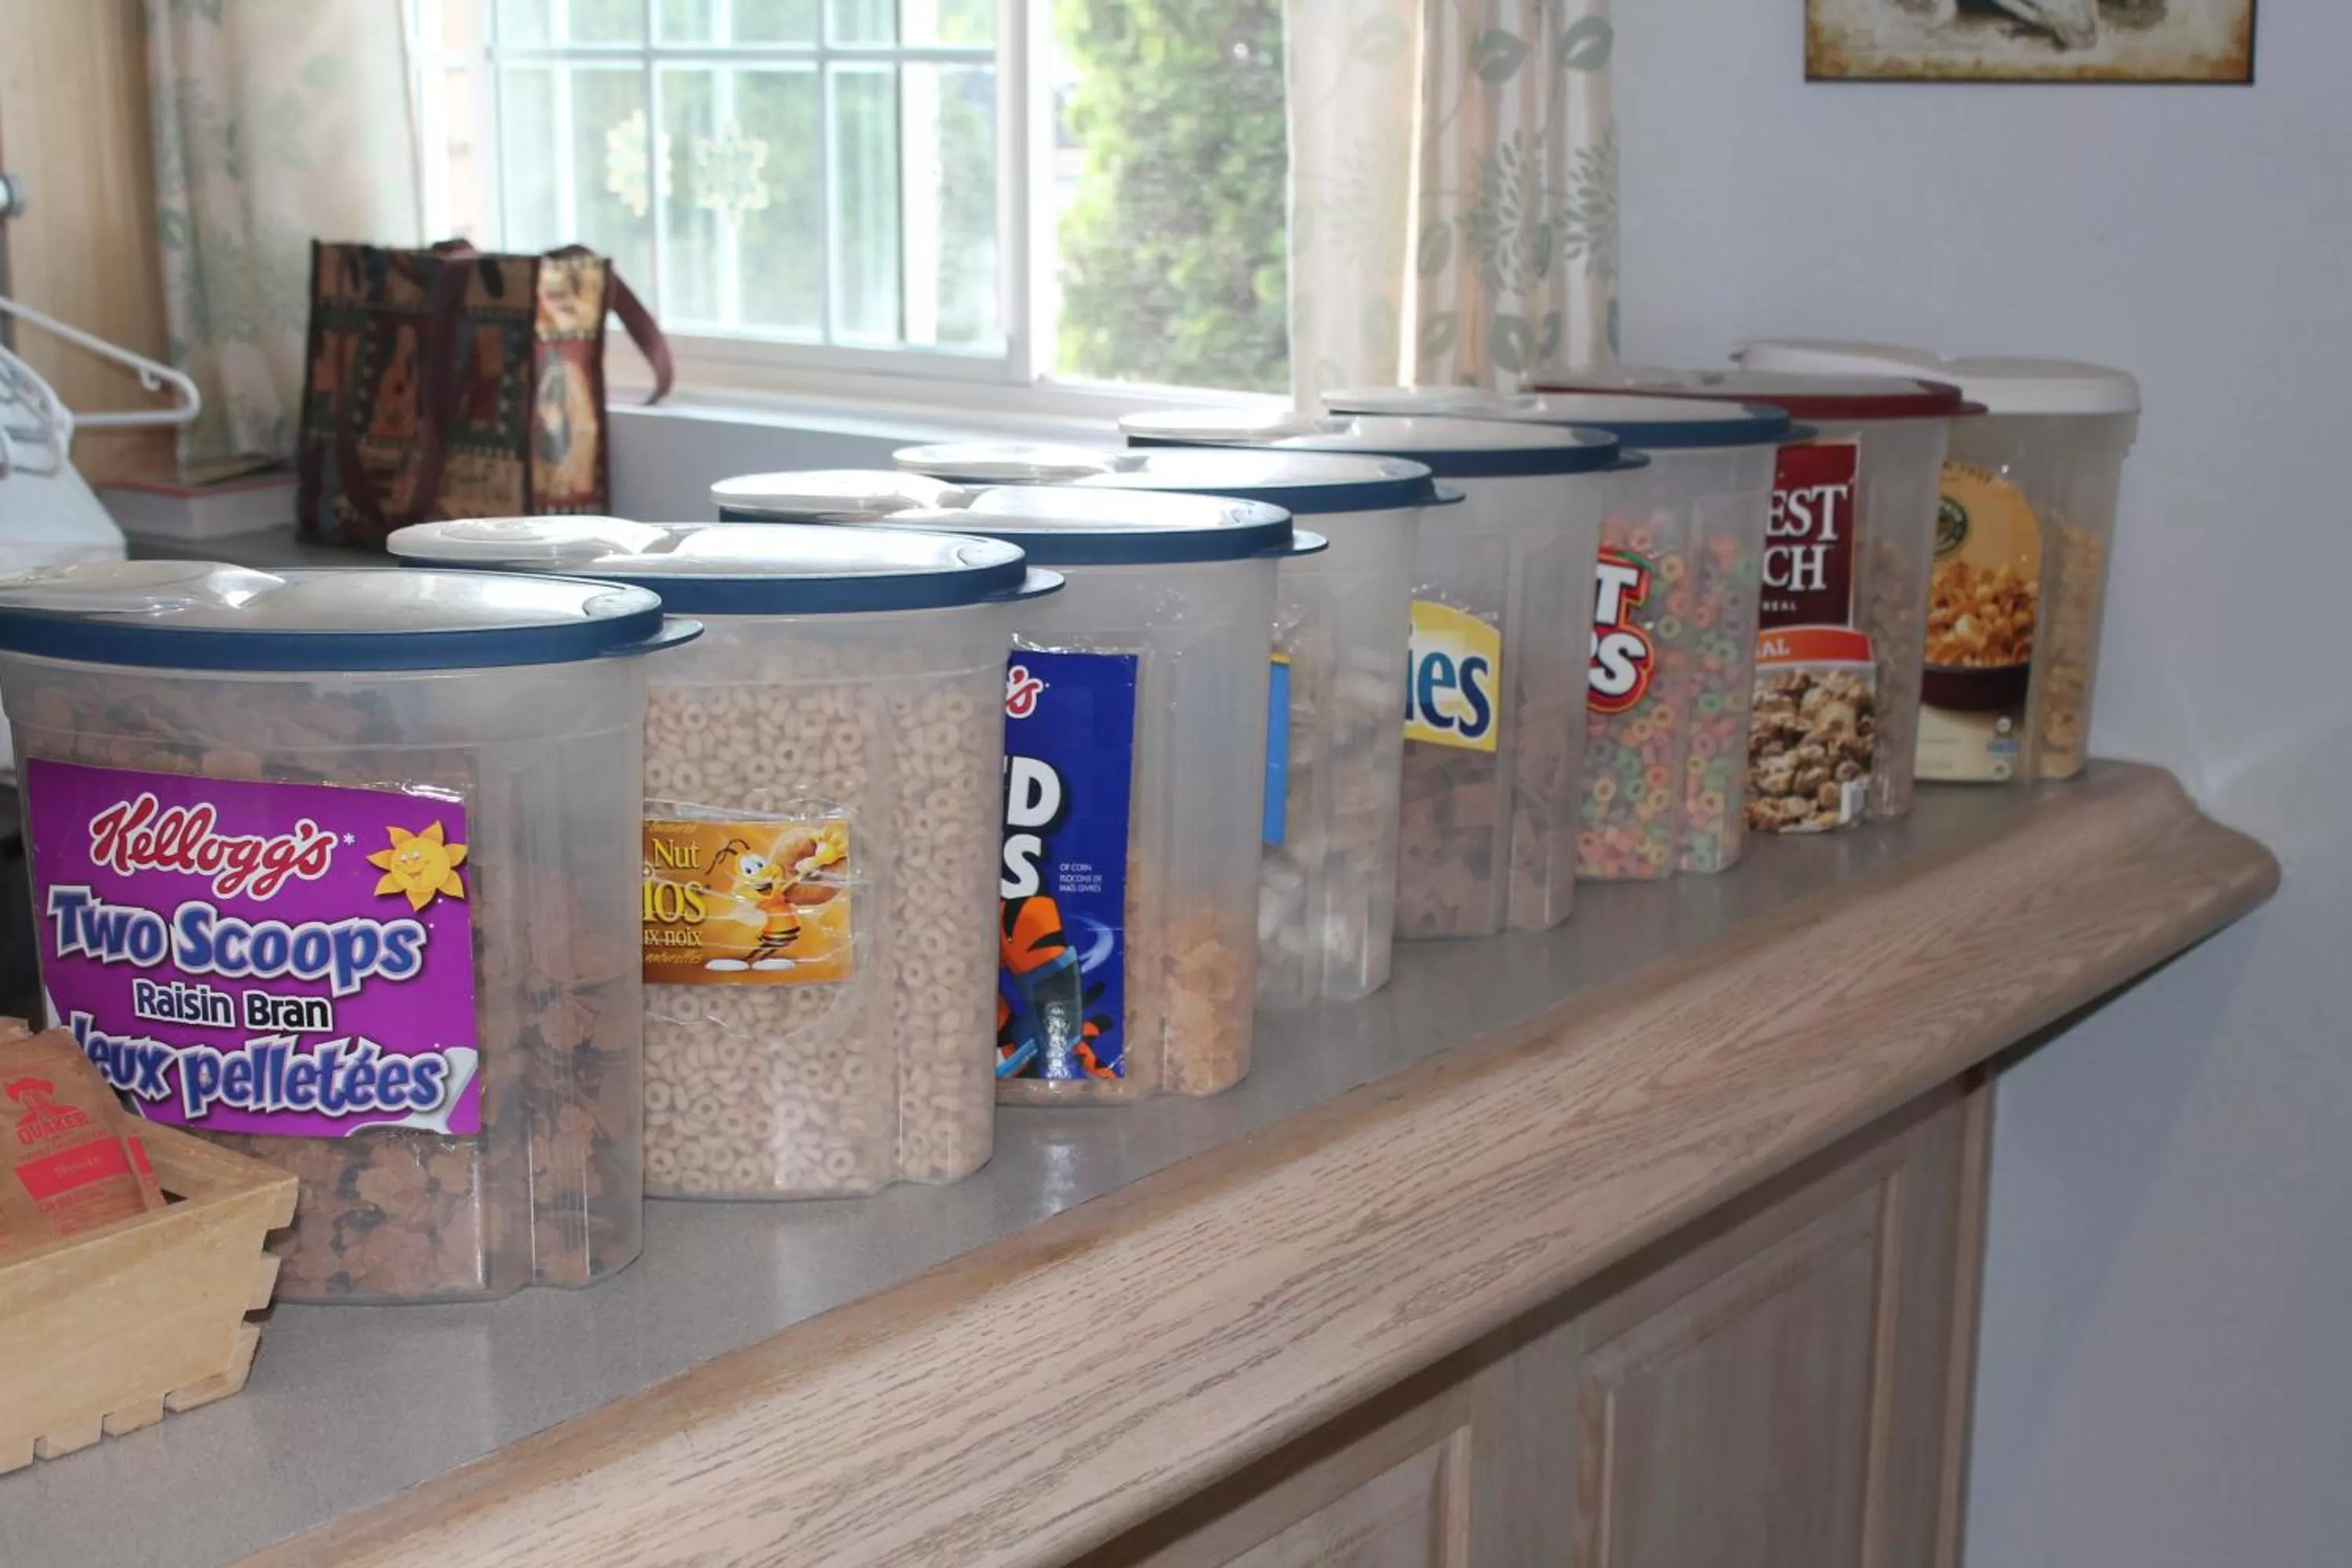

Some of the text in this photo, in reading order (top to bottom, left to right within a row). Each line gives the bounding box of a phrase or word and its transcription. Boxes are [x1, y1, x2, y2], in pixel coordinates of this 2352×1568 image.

[1766, 484, 1849, 542] EST
[1596, 564, 1639, 624] T
[1762, 543, 1828, 593] CH
[1589, 630, 1646, 695] S
[1757, 638, 1791, 658] AL
[1004, 755, 1061, 828] D
[90, 792, 337, 899] Kellogg's
[652, 837, 700, 869] Nut
[1000, 833, 1042, 899] S
[47, 885, 427, 997] Two Scoops
[665, 926, 703, 946] noix
[132, 978, 333, 1032] Raisin Bran
[179, 1035, 449, 1119] pelletées
